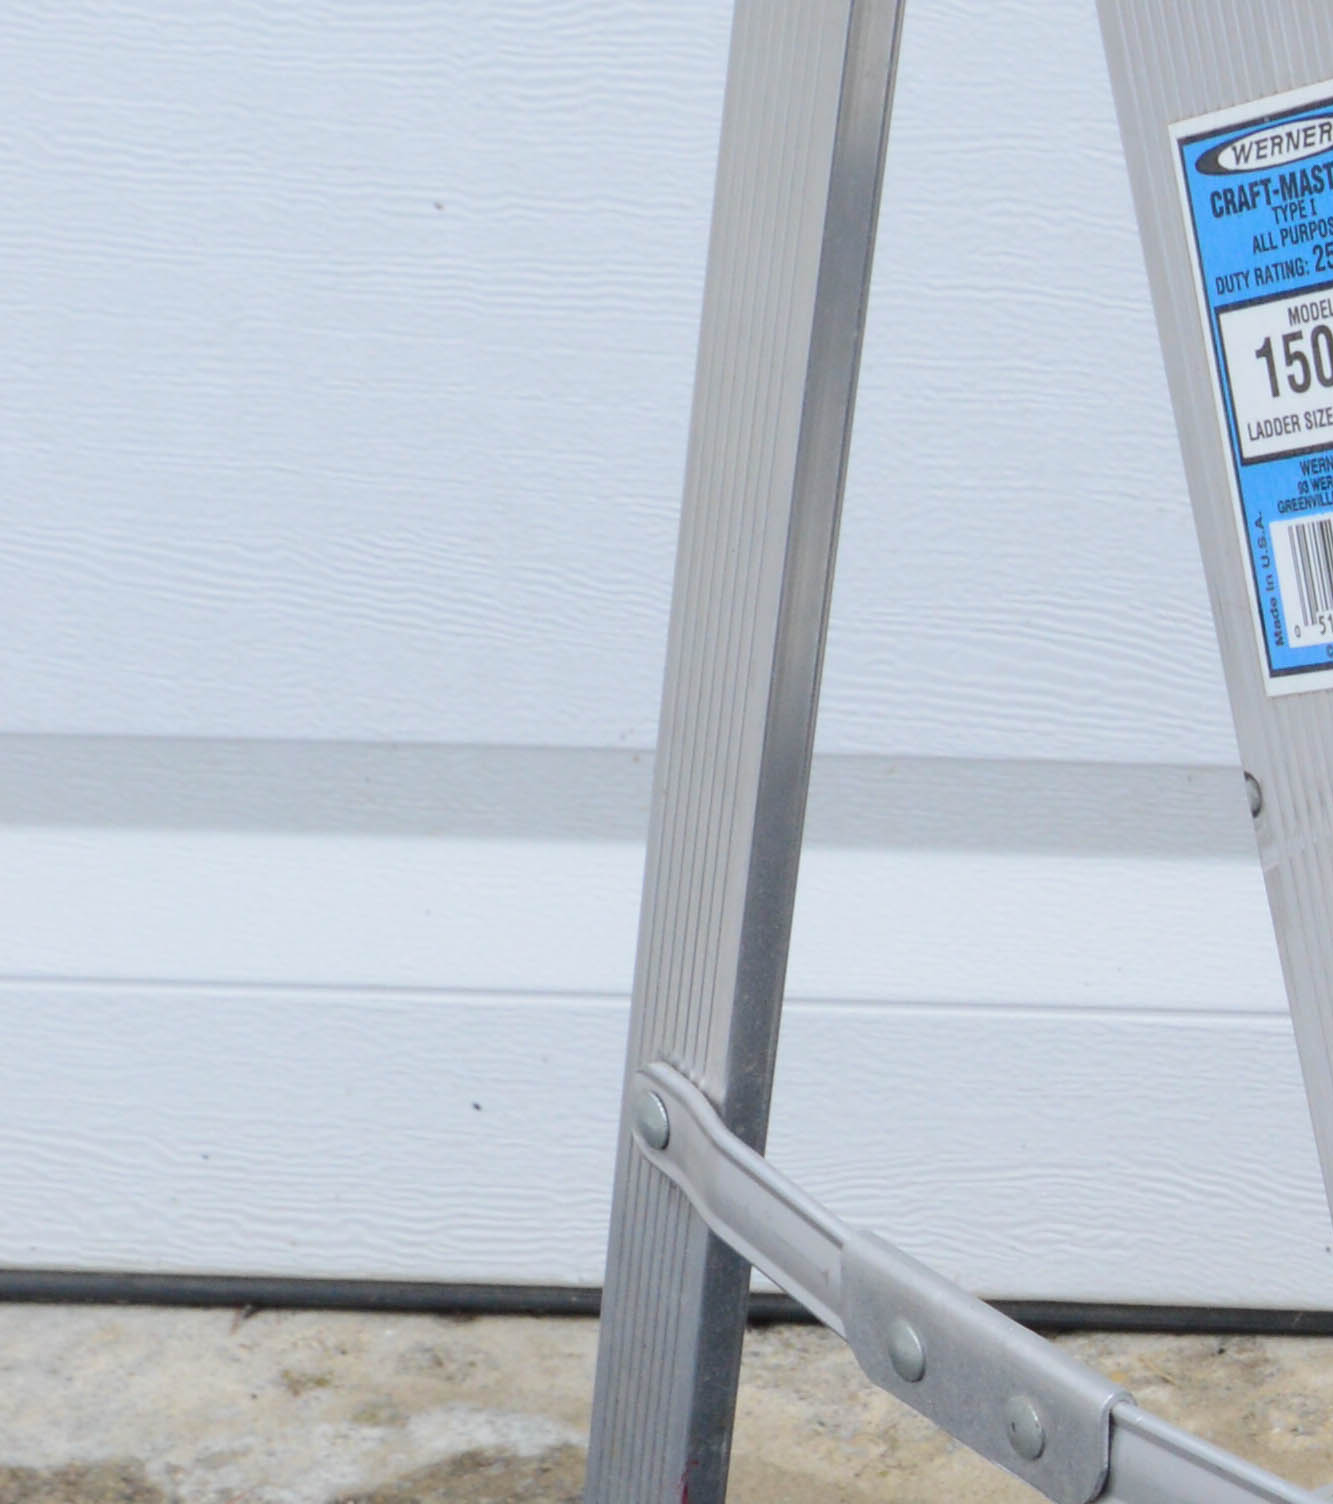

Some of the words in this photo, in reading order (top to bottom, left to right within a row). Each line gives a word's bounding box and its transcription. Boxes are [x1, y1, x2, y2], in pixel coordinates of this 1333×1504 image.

[1231, 120, 1333, 167] WERNER
[1271, 200, 1308, 225] TYPE
[1252, 232, 1278, 255] ALL
[1215, 271, 1250, 296] DUTY
[1254, 259, 1311, 288] RATING:
[1247, 414, 1301, 442] LADDER
[1255, 510, 1270, 568] U.S.A.
[1271, 597, 1284, 647] Made
